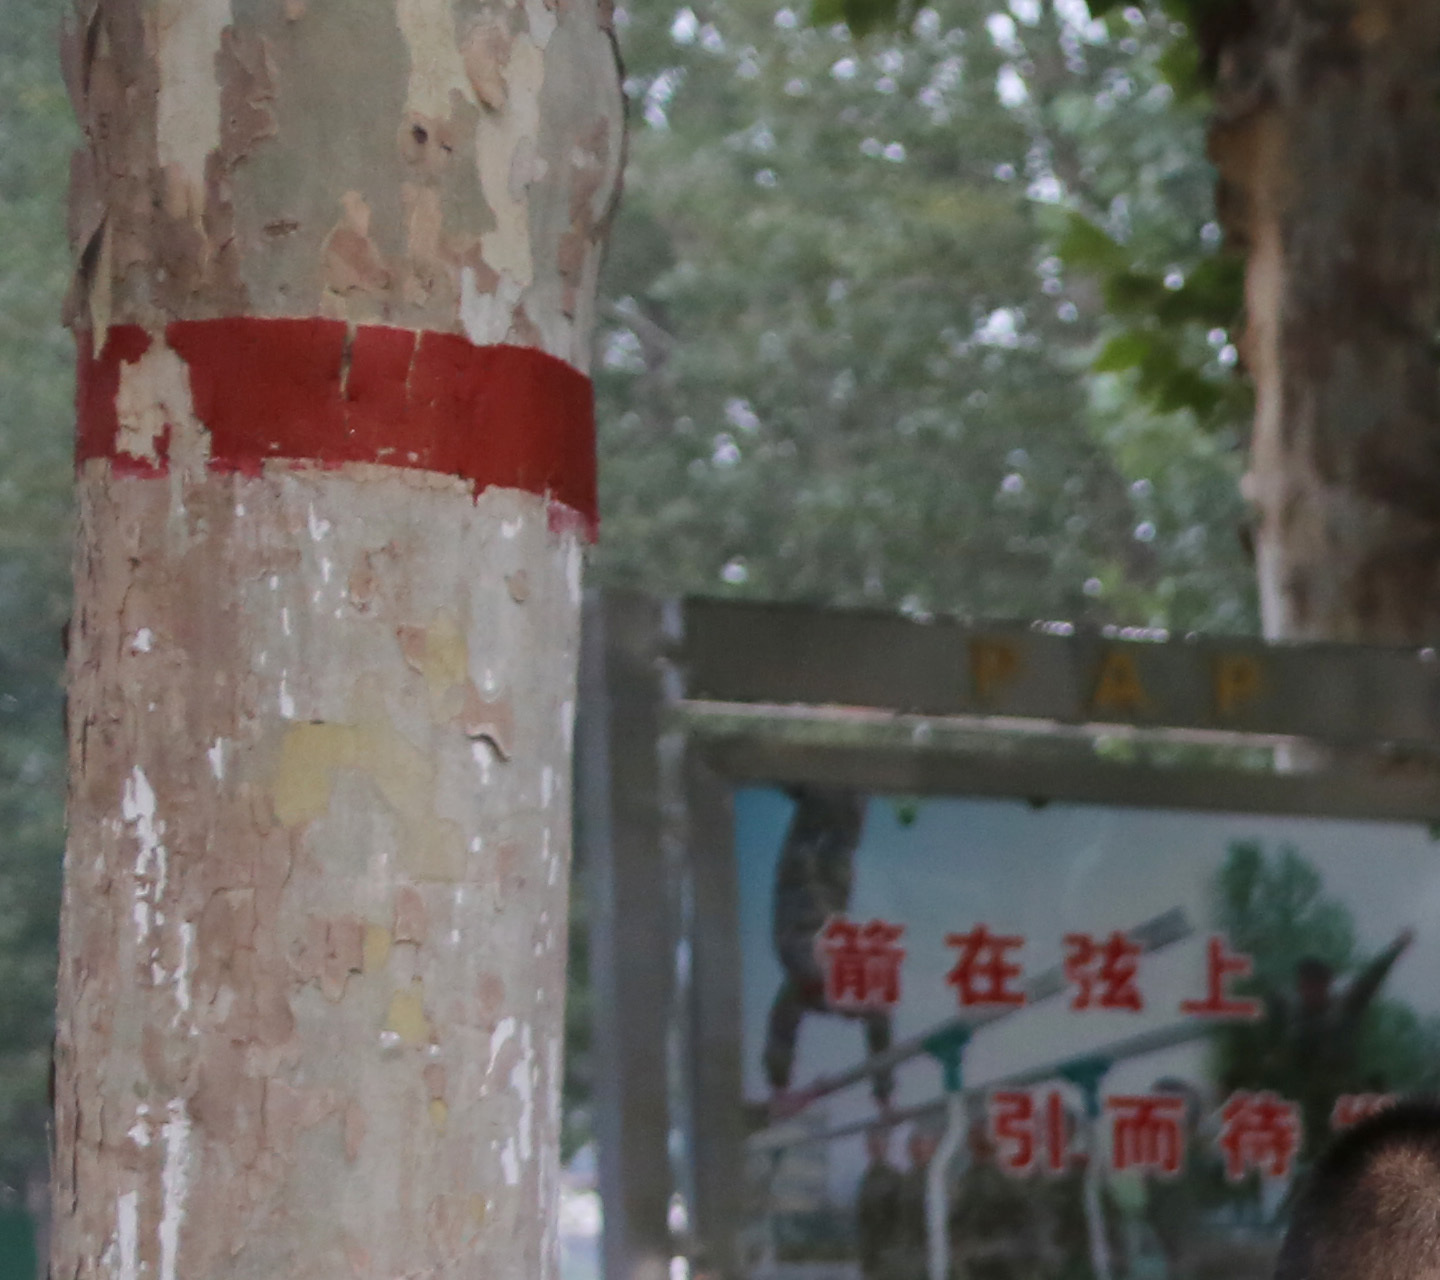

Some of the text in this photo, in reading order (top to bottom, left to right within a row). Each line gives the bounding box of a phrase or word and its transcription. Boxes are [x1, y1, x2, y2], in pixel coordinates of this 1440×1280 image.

[820, 916, 1262, 1019] 箭在弦上
[990, 1091, 1397, 1178] 引而待
